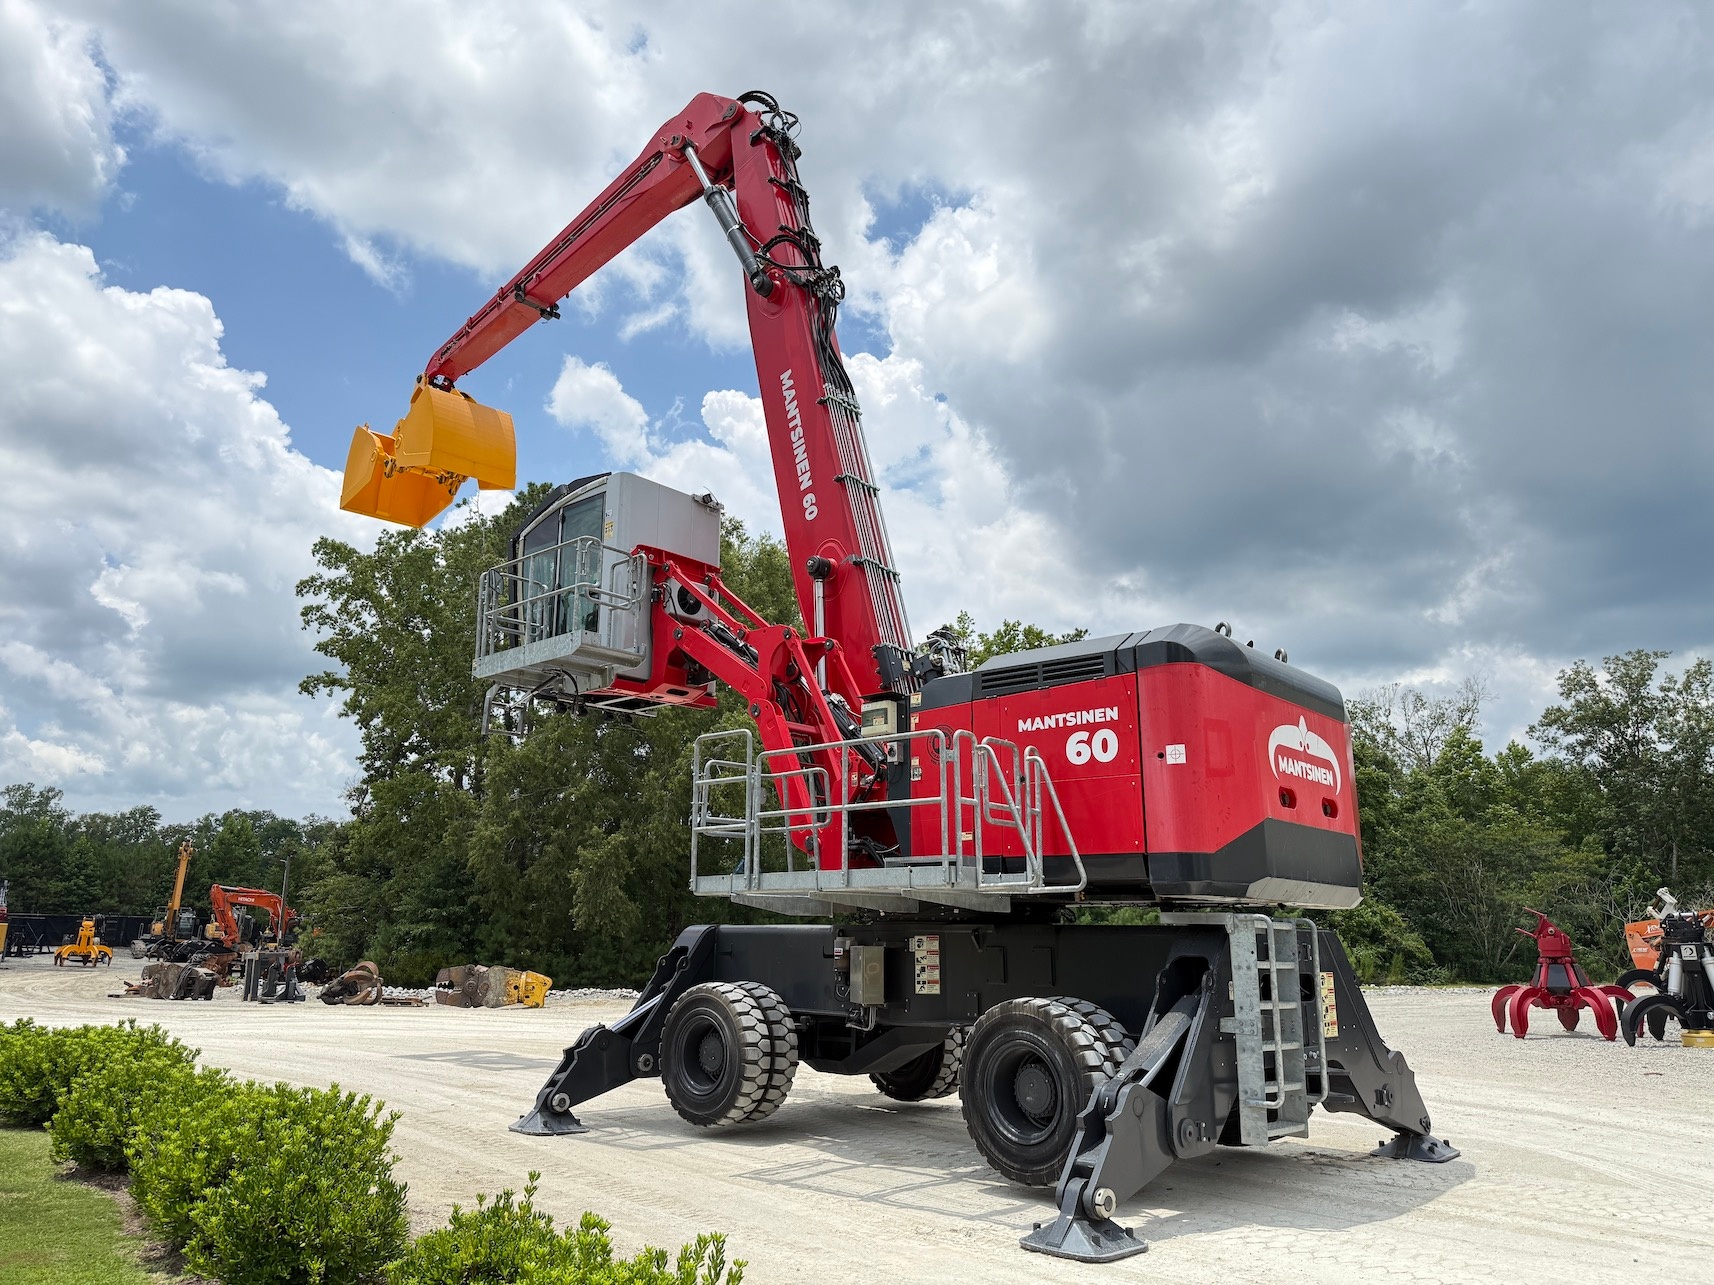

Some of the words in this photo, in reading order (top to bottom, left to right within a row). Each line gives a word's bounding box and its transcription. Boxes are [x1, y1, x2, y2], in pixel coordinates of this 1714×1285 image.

[779, 368, 813, 491] MANTSINEN
[802, 492, 818, 521] 60
[1017, 706, 1119, 732] MANTSINEN
[1065, 728, 1119, 765] 60
[1278, 754, 1334, 787] MANTSINEN
